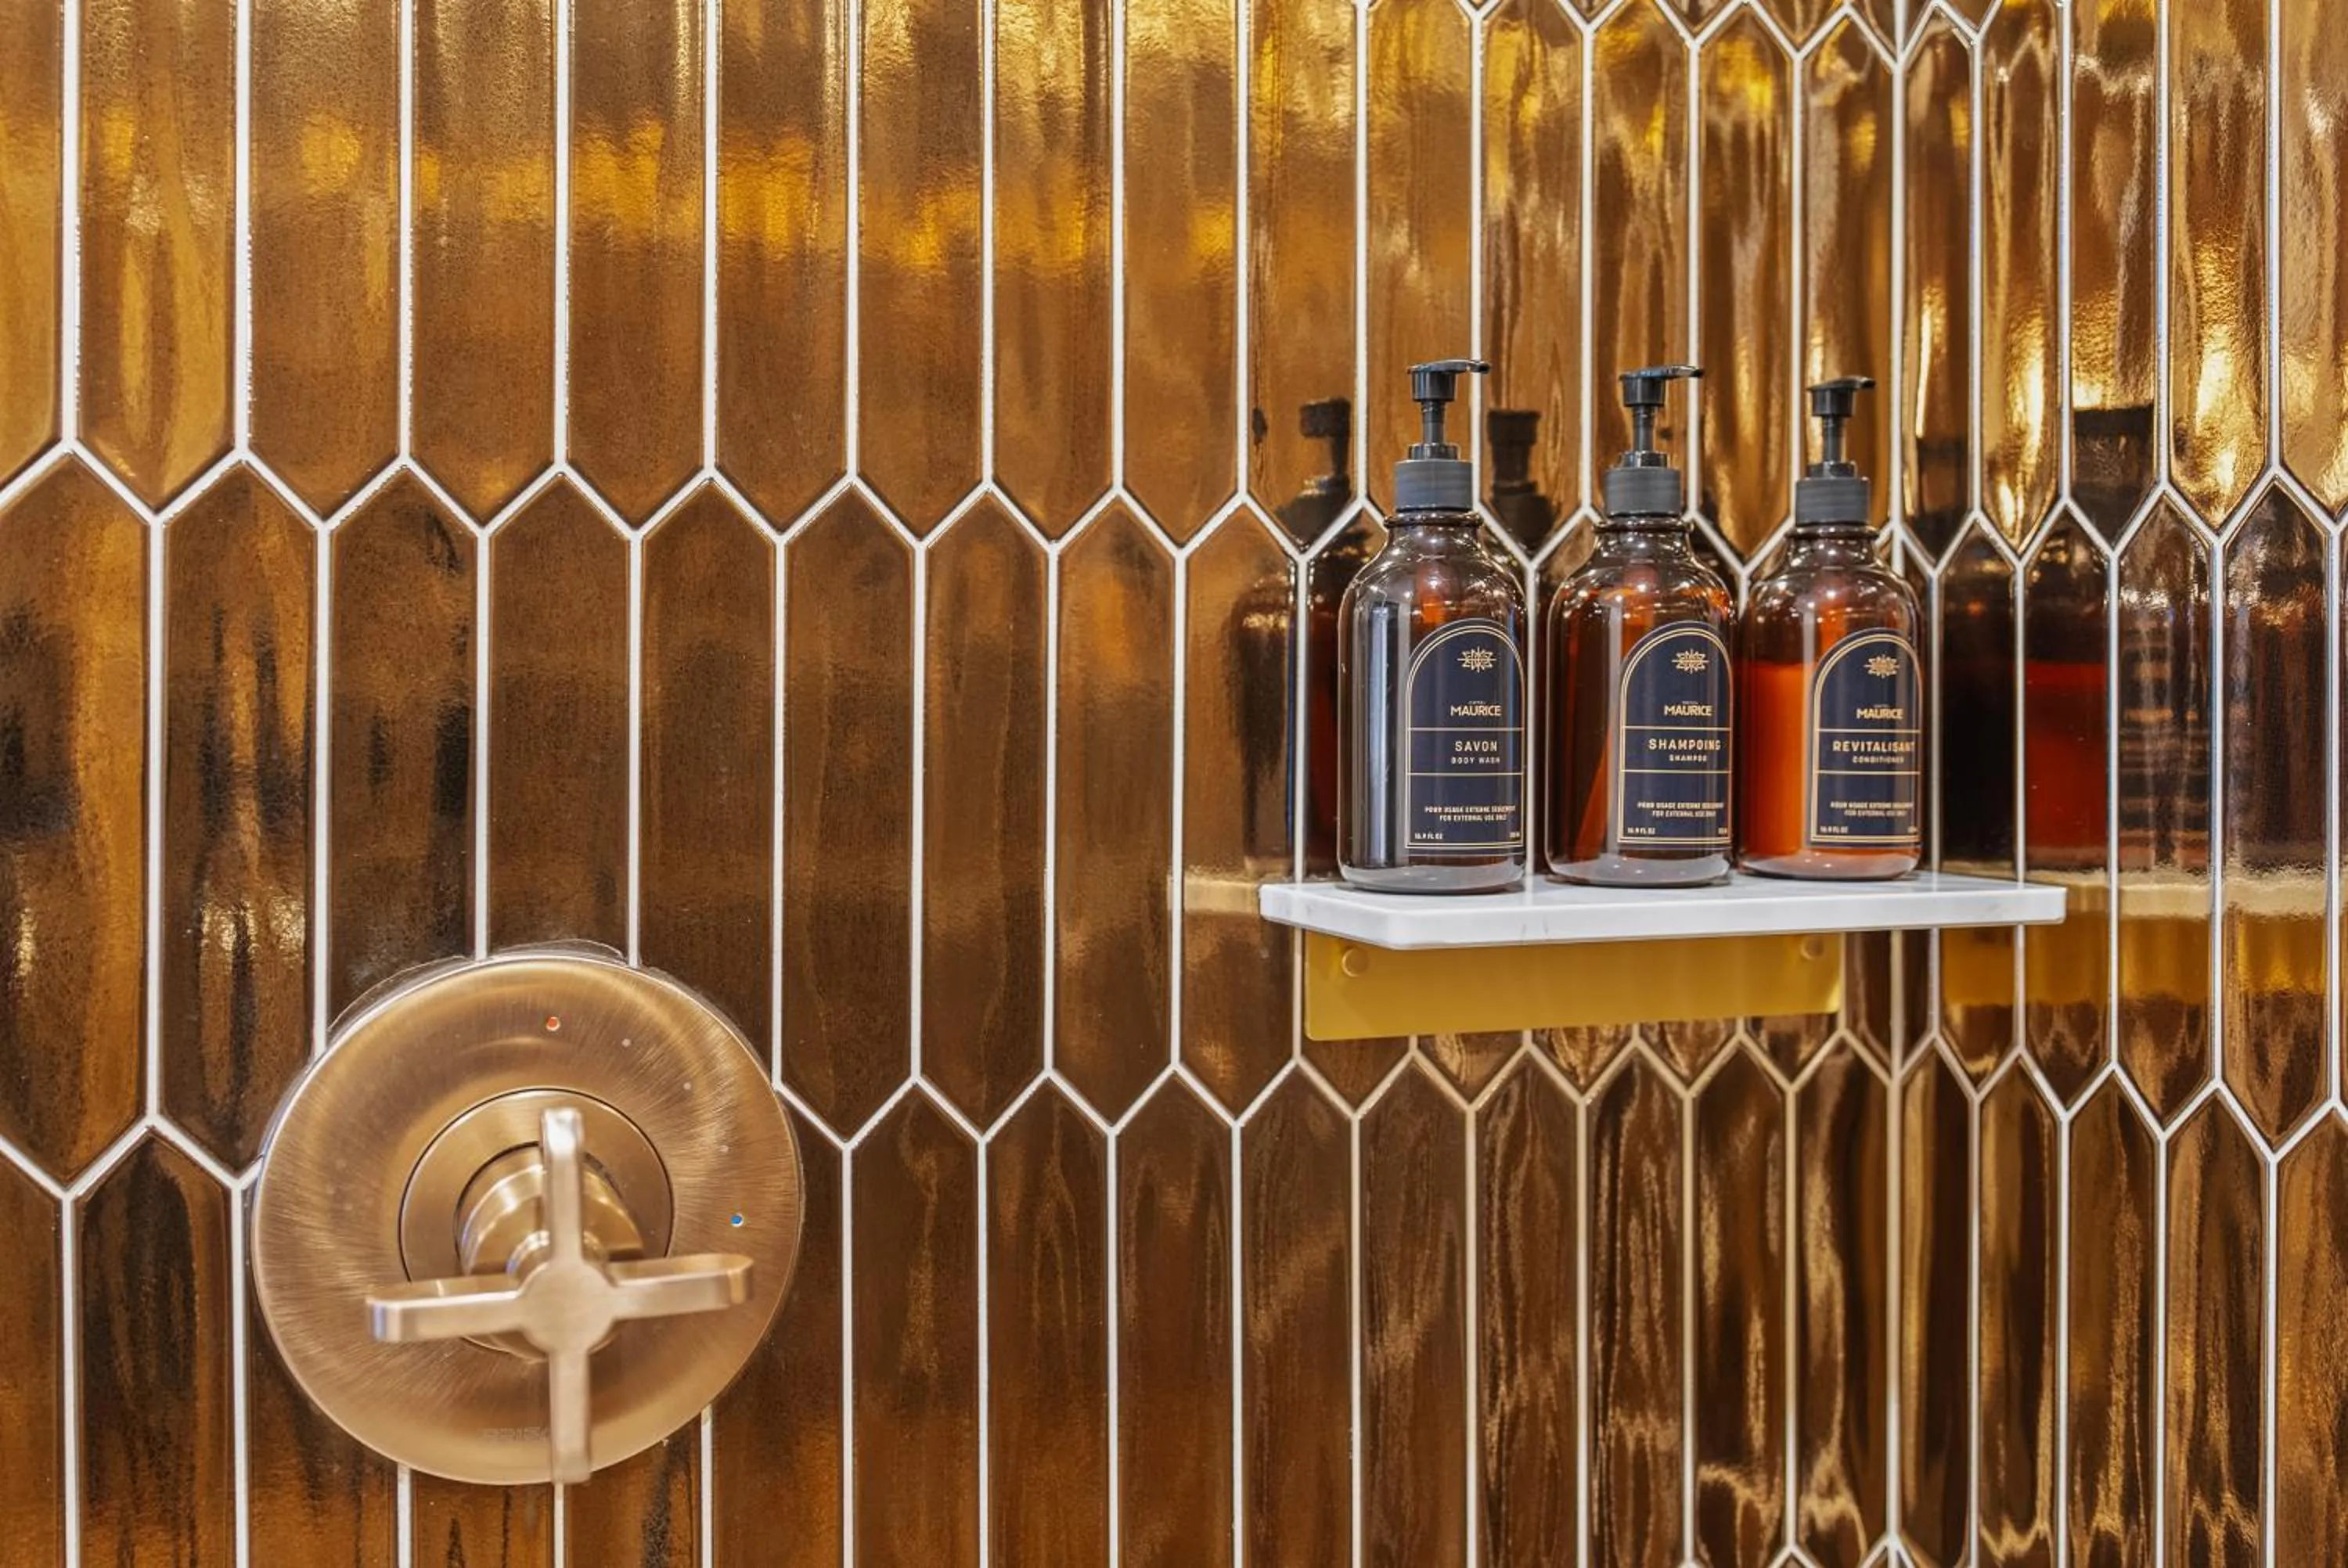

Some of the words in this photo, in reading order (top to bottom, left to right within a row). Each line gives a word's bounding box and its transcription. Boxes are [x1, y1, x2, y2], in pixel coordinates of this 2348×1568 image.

[1450, 705, 1502, 716] MAURICE
[1664, 705, 1712, 716] MAURICE
[1856, 708, 1903, 719] MAURICE
[1455, 741, 1497, 752] SAVON
